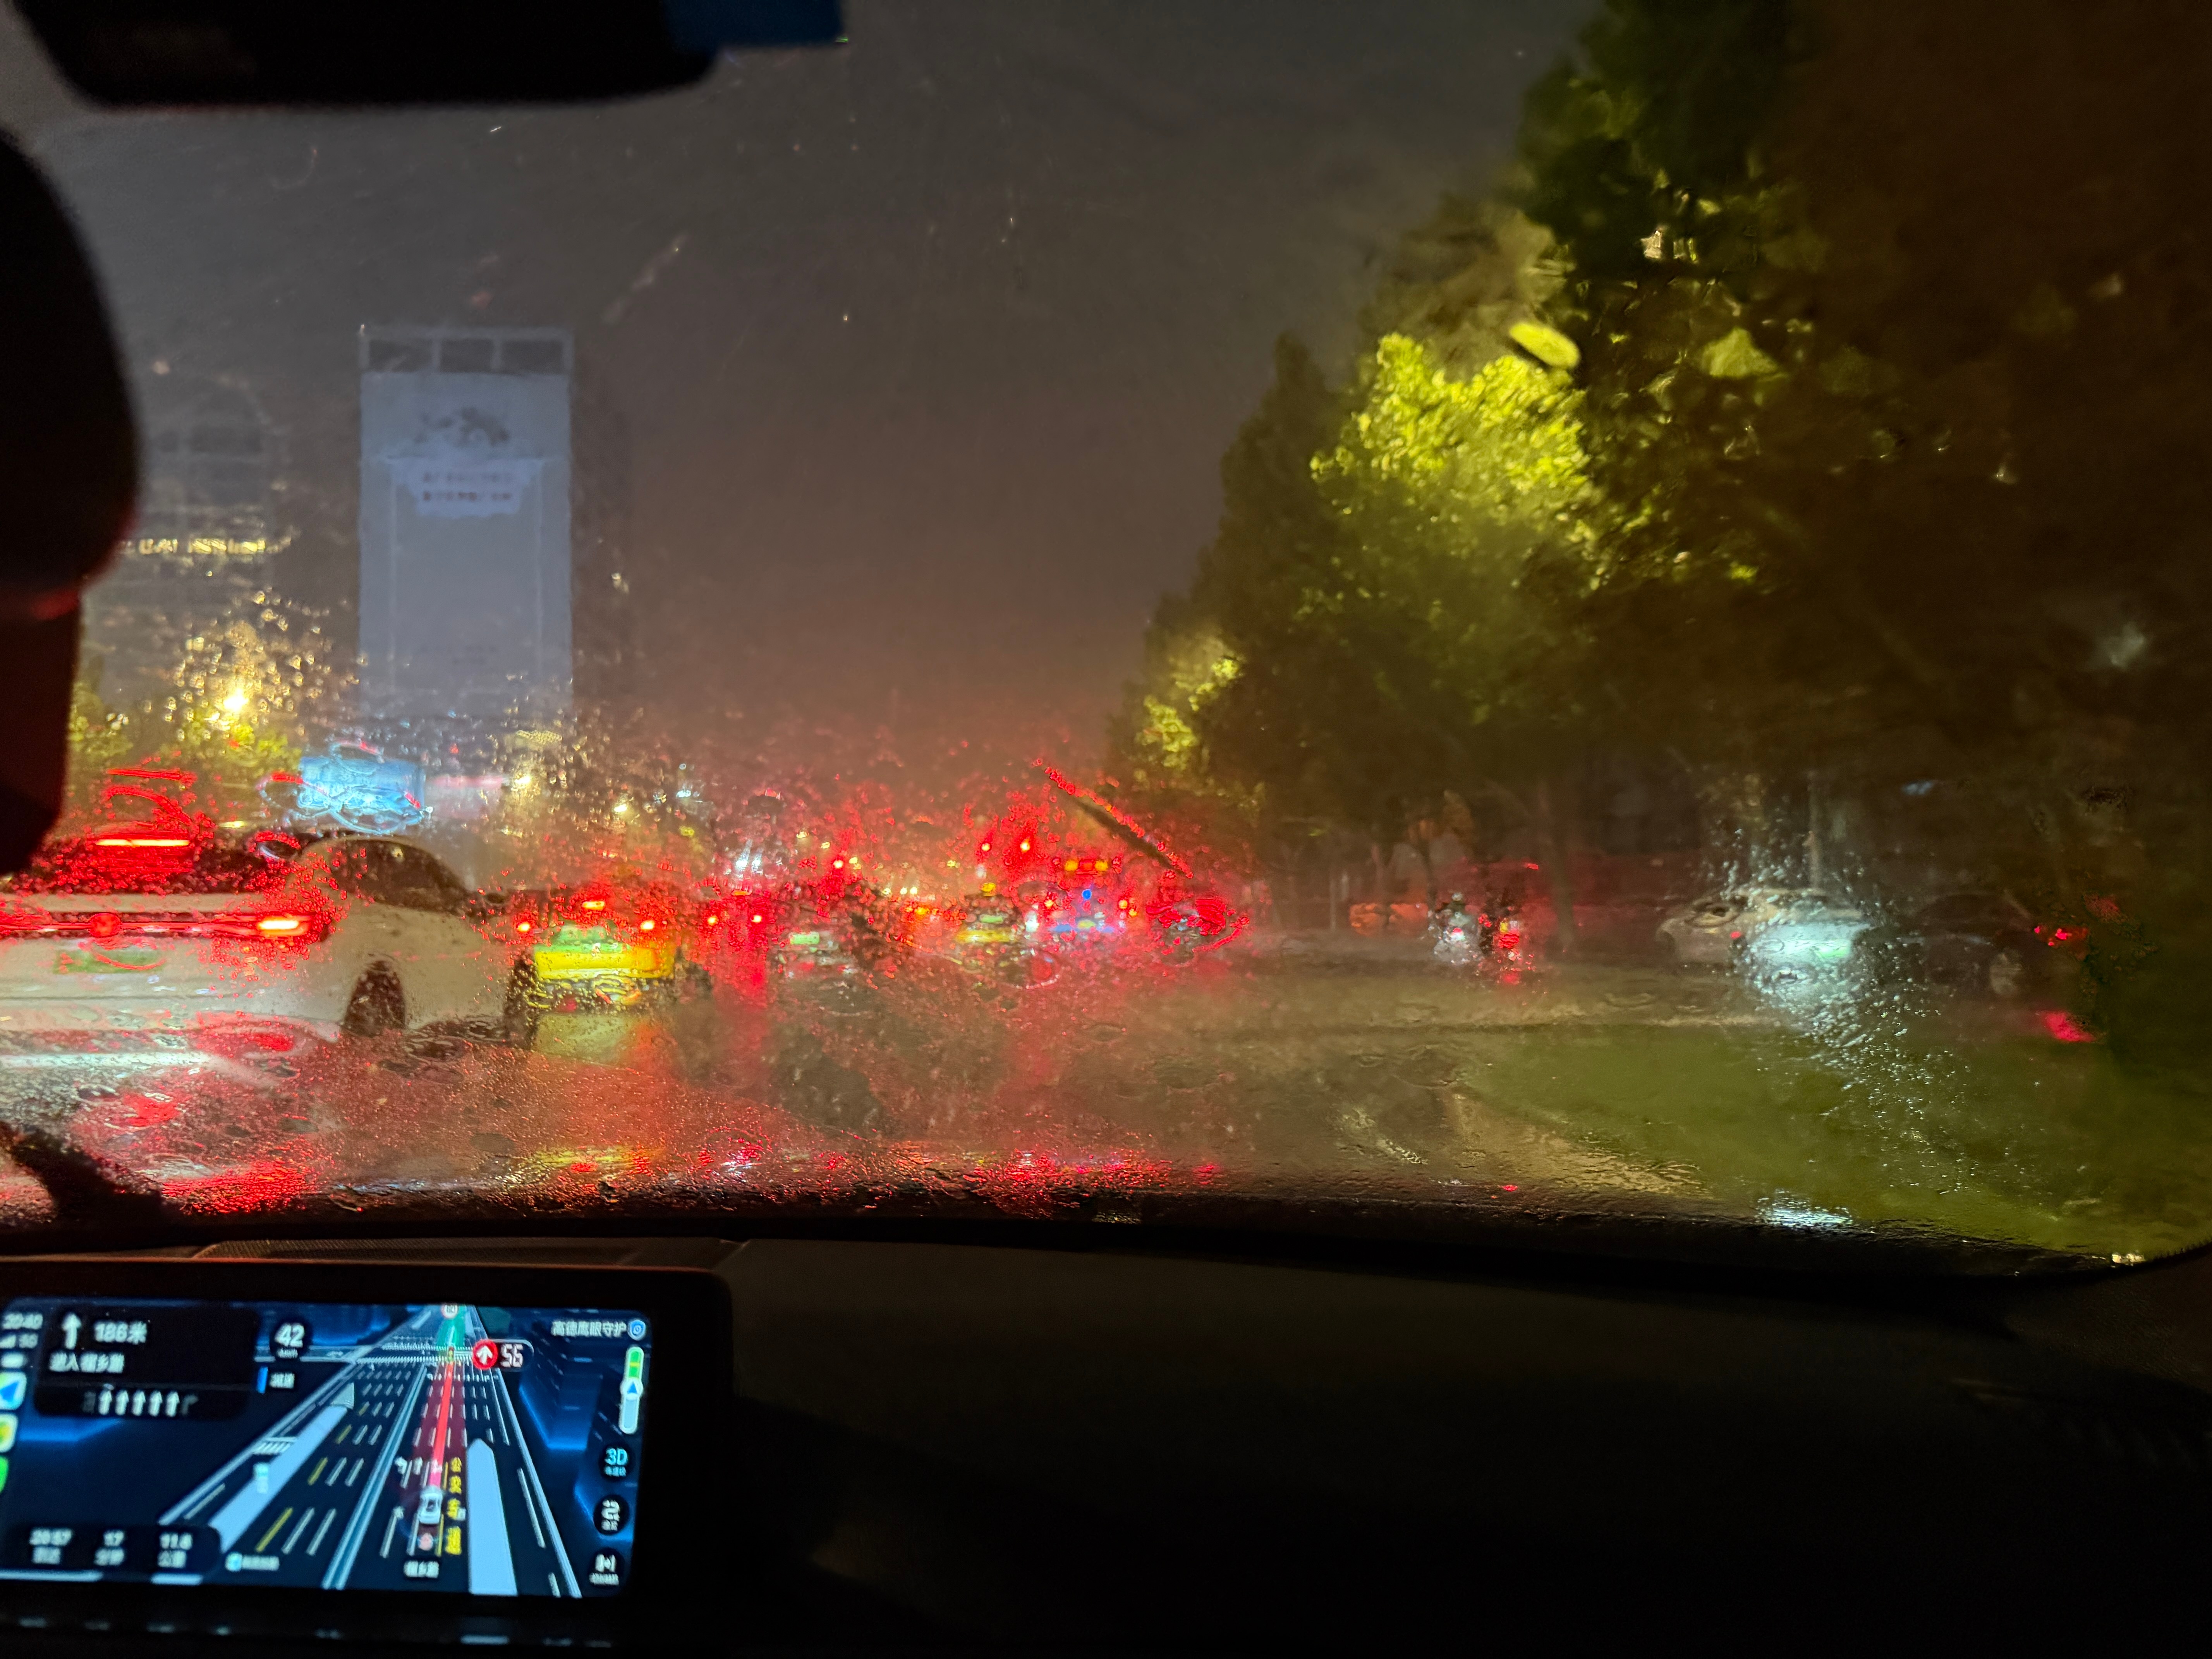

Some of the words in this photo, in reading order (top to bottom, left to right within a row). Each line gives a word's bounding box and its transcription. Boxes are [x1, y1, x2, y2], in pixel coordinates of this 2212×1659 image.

[95, 1320, 150, 1345] 186米
[275, 1323, 305, 1347] 42
[605, 1447, 628, 1465] 3D
